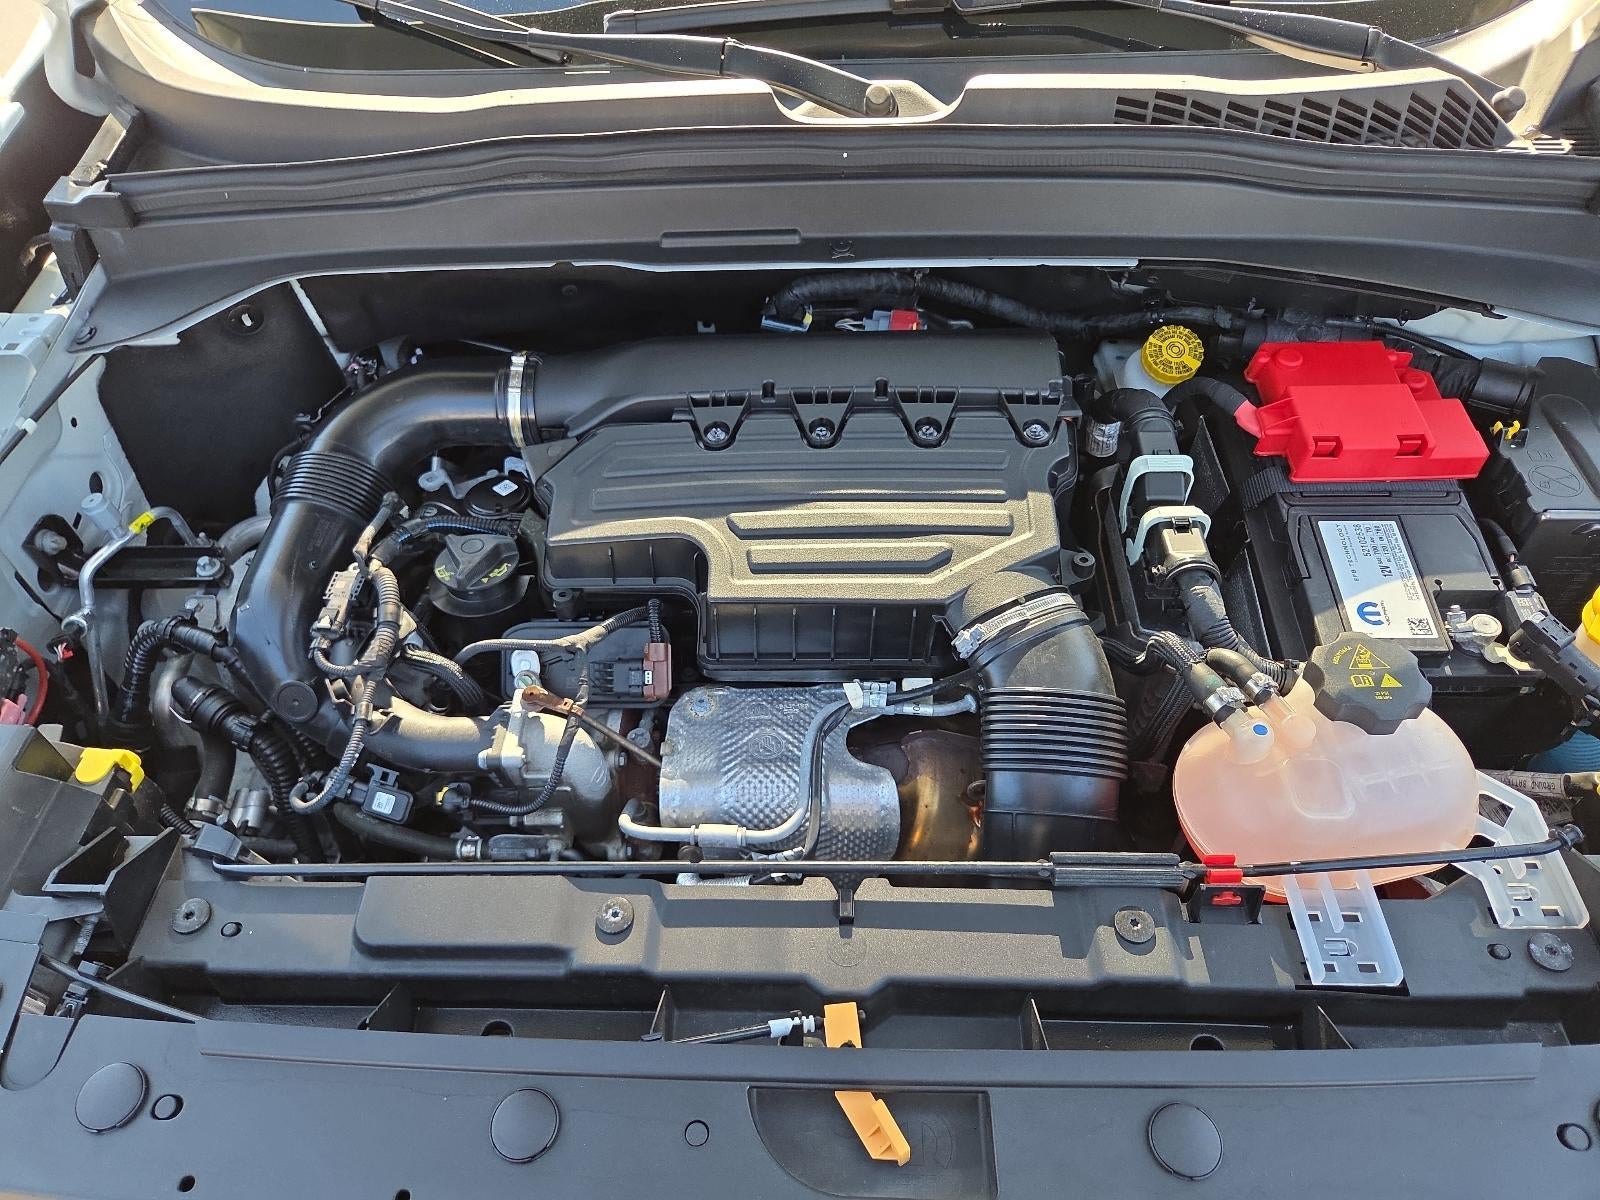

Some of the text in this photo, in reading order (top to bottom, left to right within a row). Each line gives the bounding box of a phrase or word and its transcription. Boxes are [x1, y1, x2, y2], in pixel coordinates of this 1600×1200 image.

[1335, 524, 1353, 567] TECHNOLOGY
[1378, 565, 1393, 578] 12V
[1530, 781, 1556, 791] GROUND
